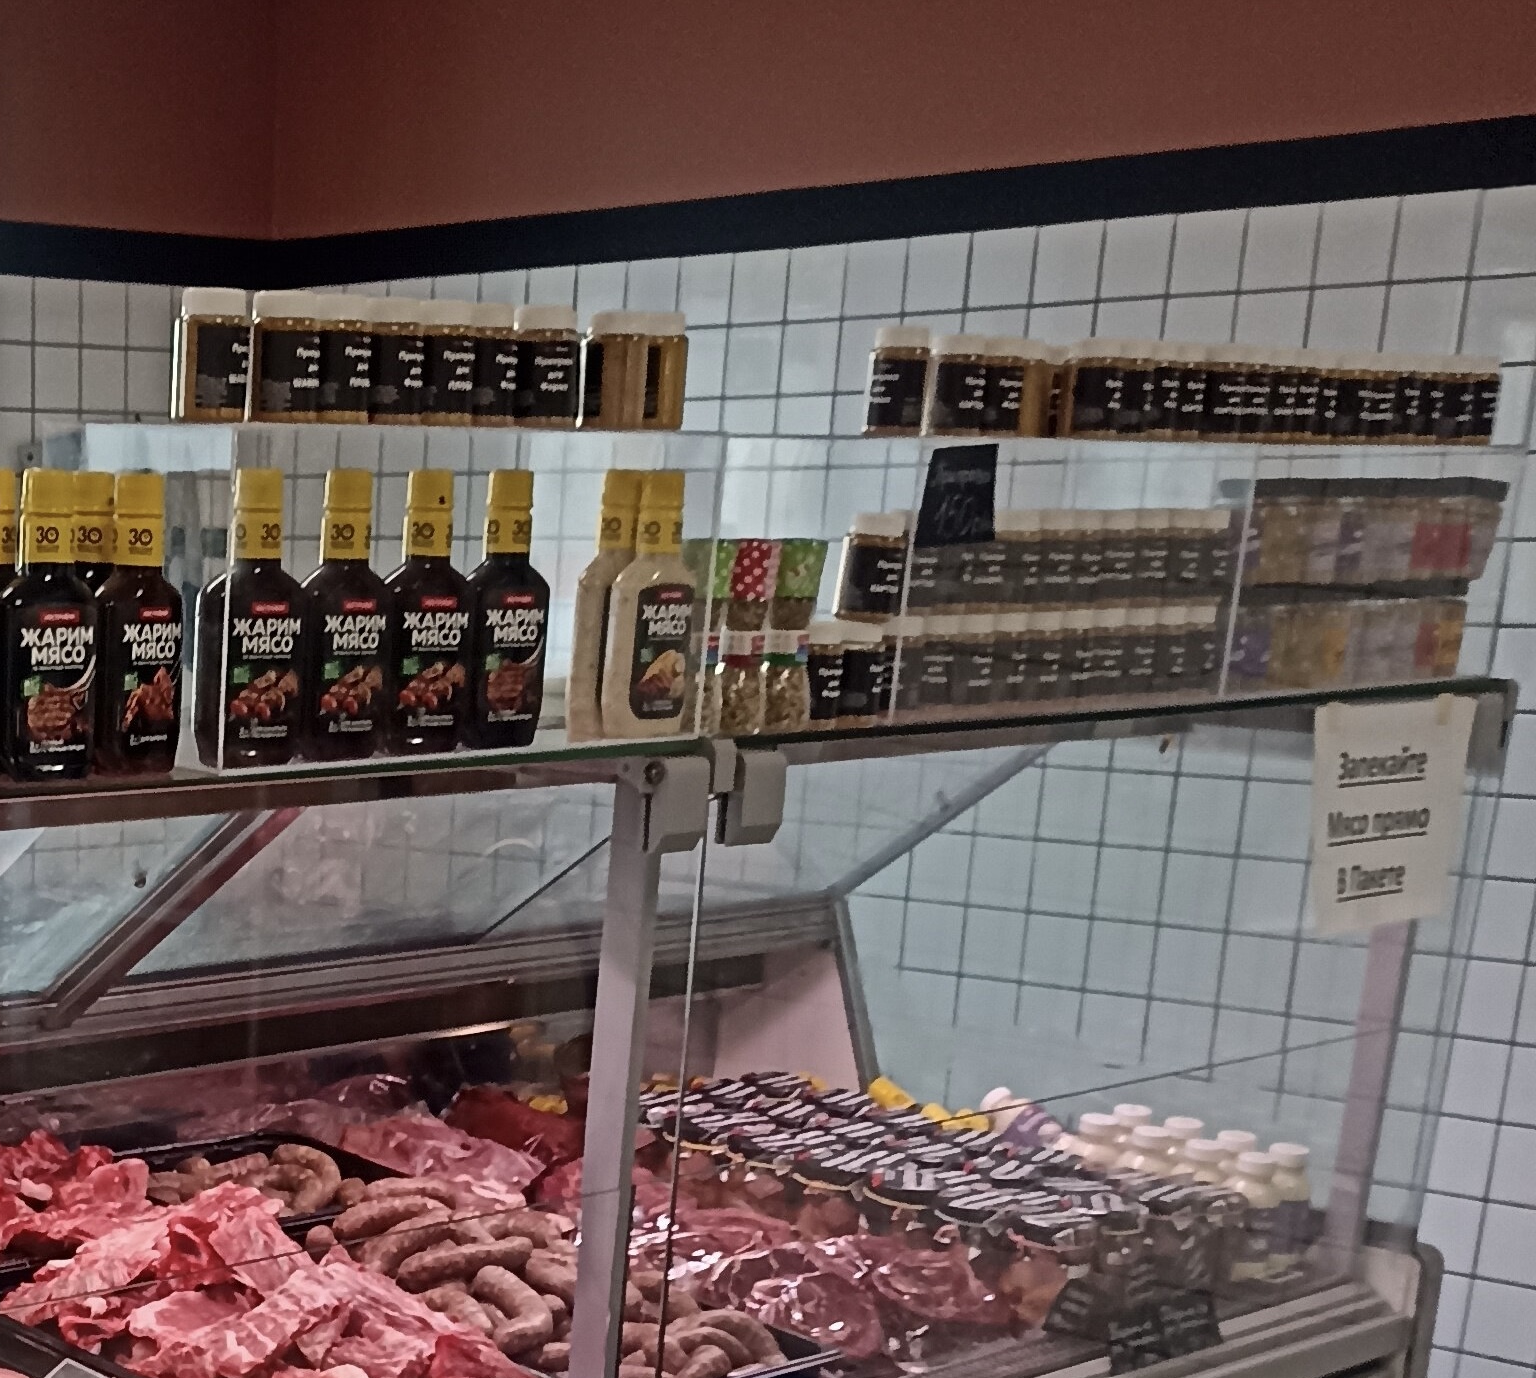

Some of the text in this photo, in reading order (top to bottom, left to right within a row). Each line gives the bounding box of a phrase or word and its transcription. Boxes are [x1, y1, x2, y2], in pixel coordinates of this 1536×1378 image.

[36, 526, 59, 544] 30
[77, 527, 102, 544] 30
[129, 528, 153, 546] 30
[261, 523, 281, 540] 30
[330, 523, 355, 541] 30
[324, 615, 387, 633] ЖАРИМ
[403, 612, 469, 631] ЖАРИМ
[486, 609, 545, 627] ЖАРИМ
[123, 622, 182, 643] ЖАРИМ
[233, 618, 302, 637] ЖАРИМ
[493, 625, 539, 642] МЯСО
[21, 626, 94, 648] ЖАРИМ
[242, 636, 294, 654] МЯСО
[333, 632, 380, 651] МЯСО
[411, 630, 462, 647] МЯСО
[31, 646, 86, 666] МЯСО
[131, 641, 176, 660] МЯСО
